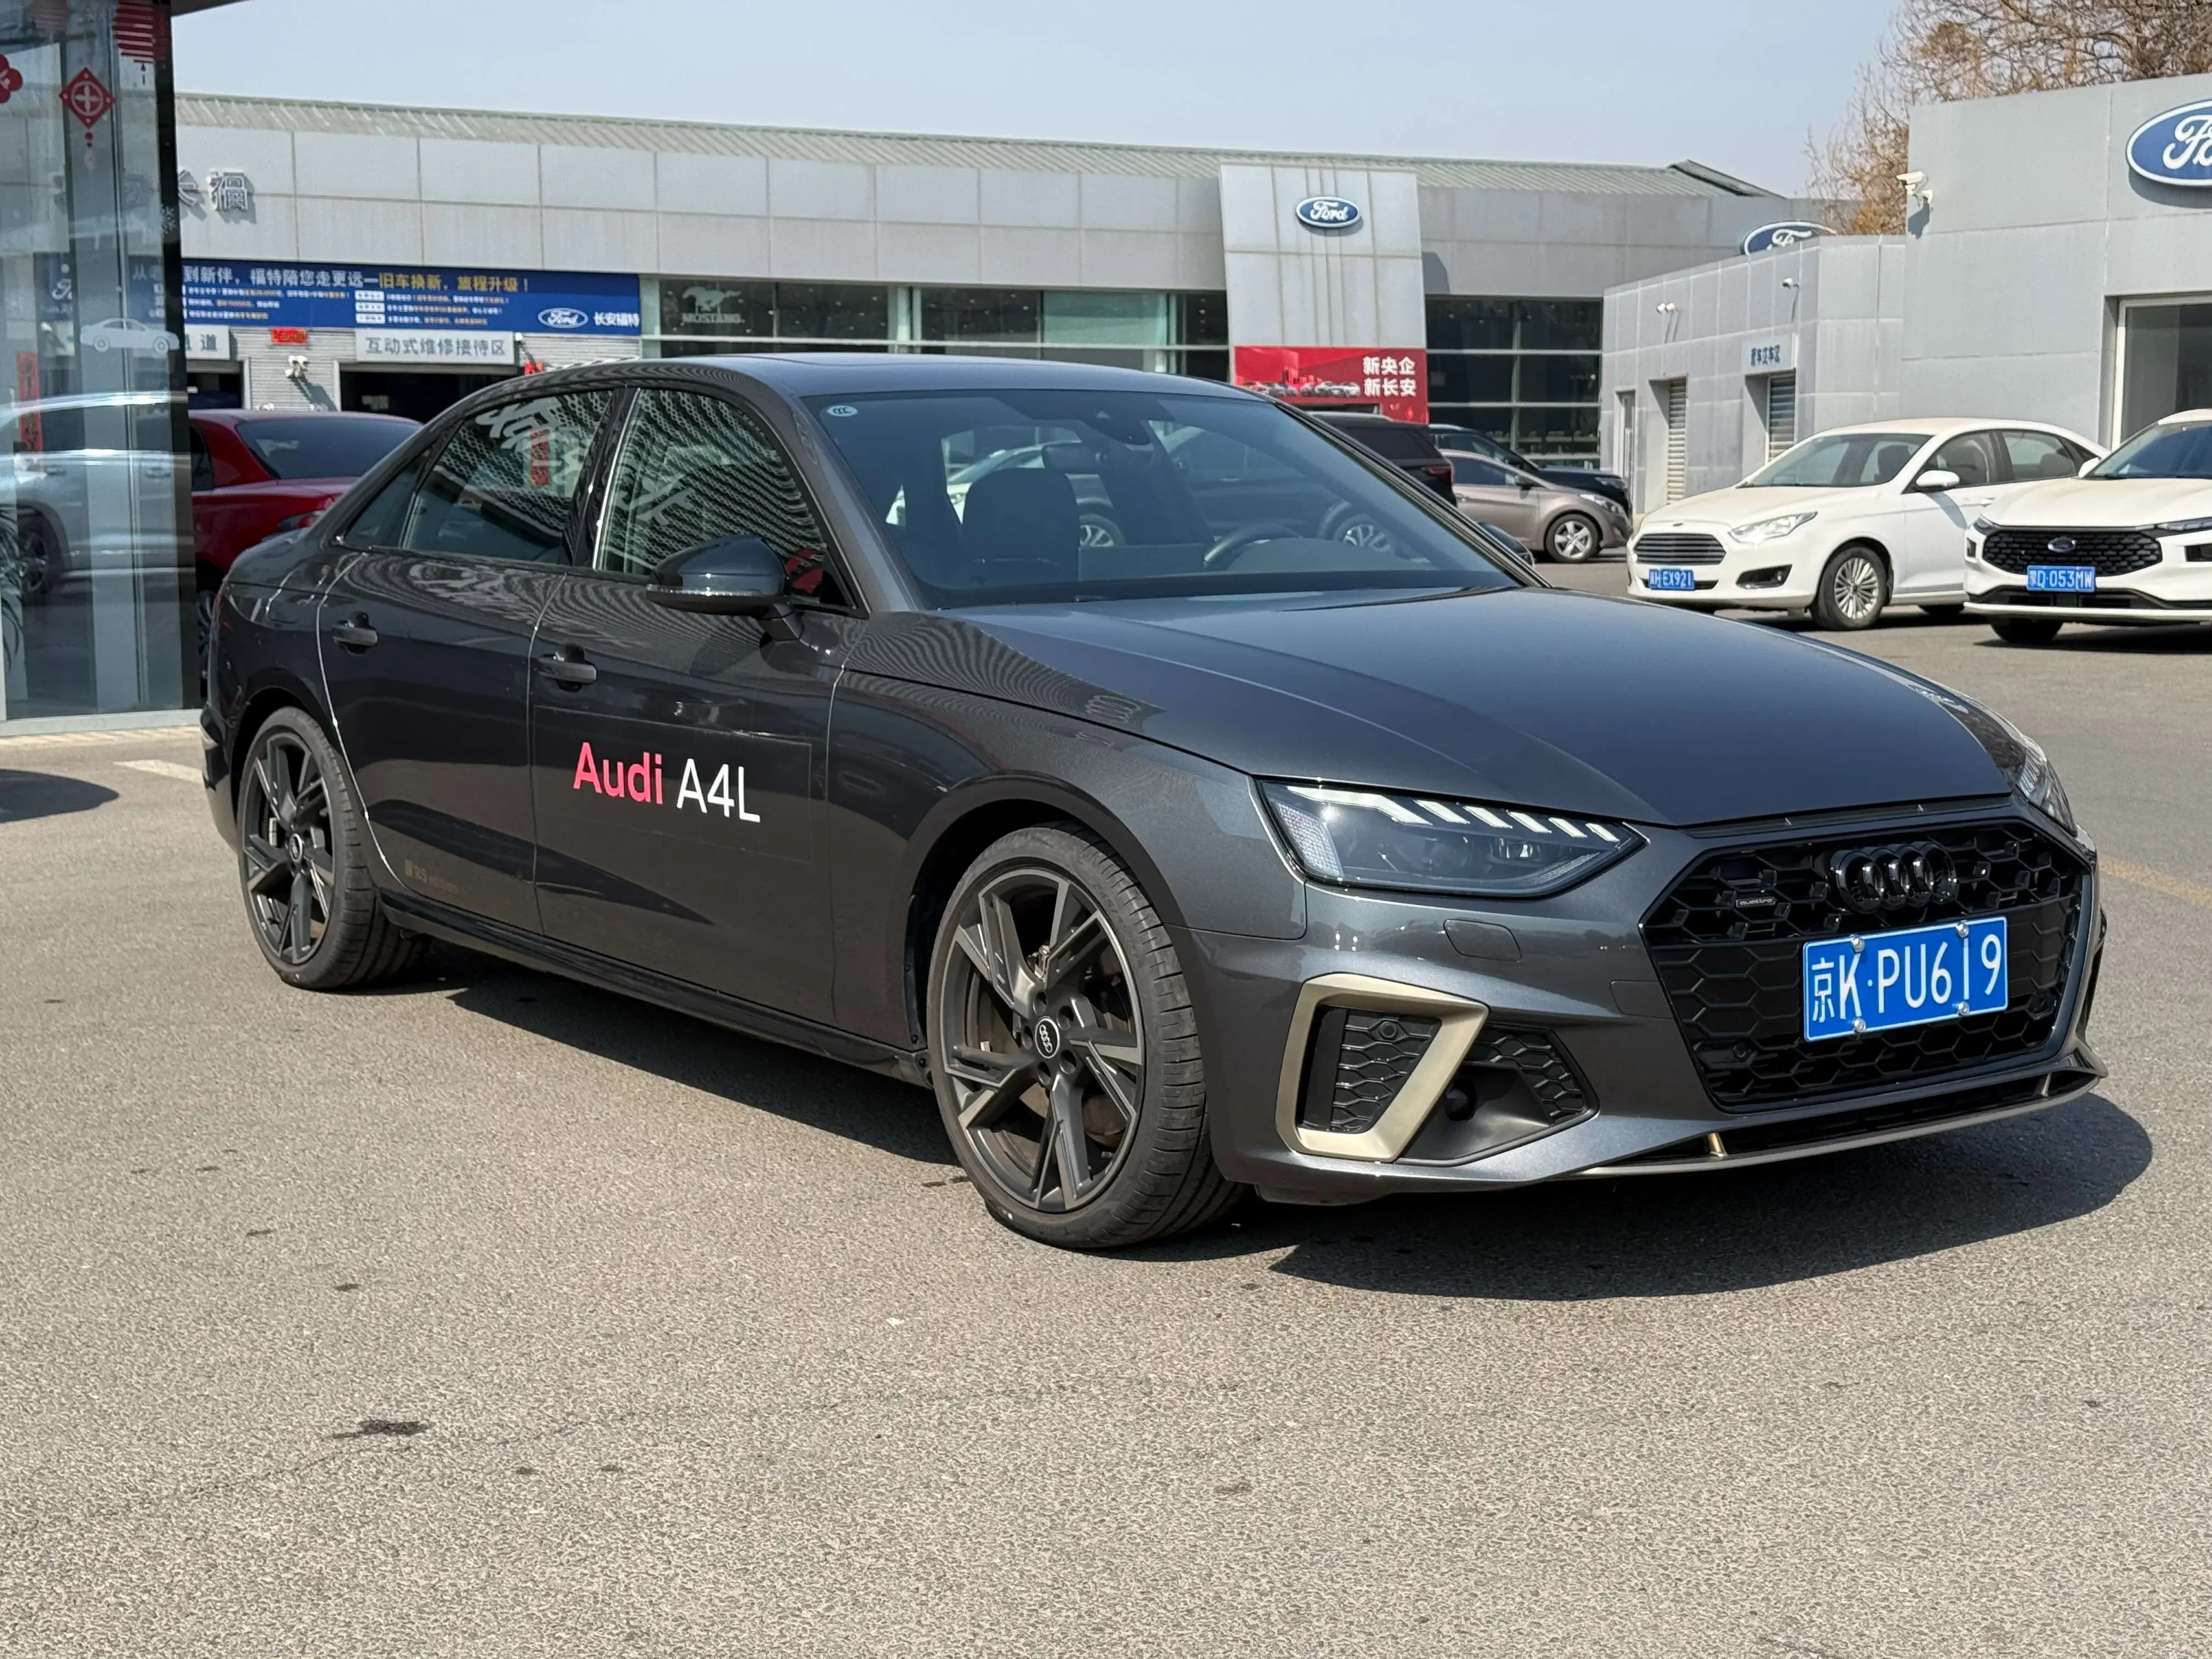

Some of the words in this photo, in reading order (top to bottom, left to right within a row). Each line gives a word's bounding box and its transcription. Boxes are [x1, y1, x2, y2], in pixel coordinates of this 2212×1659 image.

[1310, 201, 1349, 221] Ford
[593, 312, 640, 328] 长安福特
[365, 337, 505, 357] 互动式维修接待区
[1362, 356, 1416, 376] 新央企
[1363, 379, 1417, 397] 新长安
[572, 742, 663, 805] Audi
[676, 758, 761, 823] A4L
